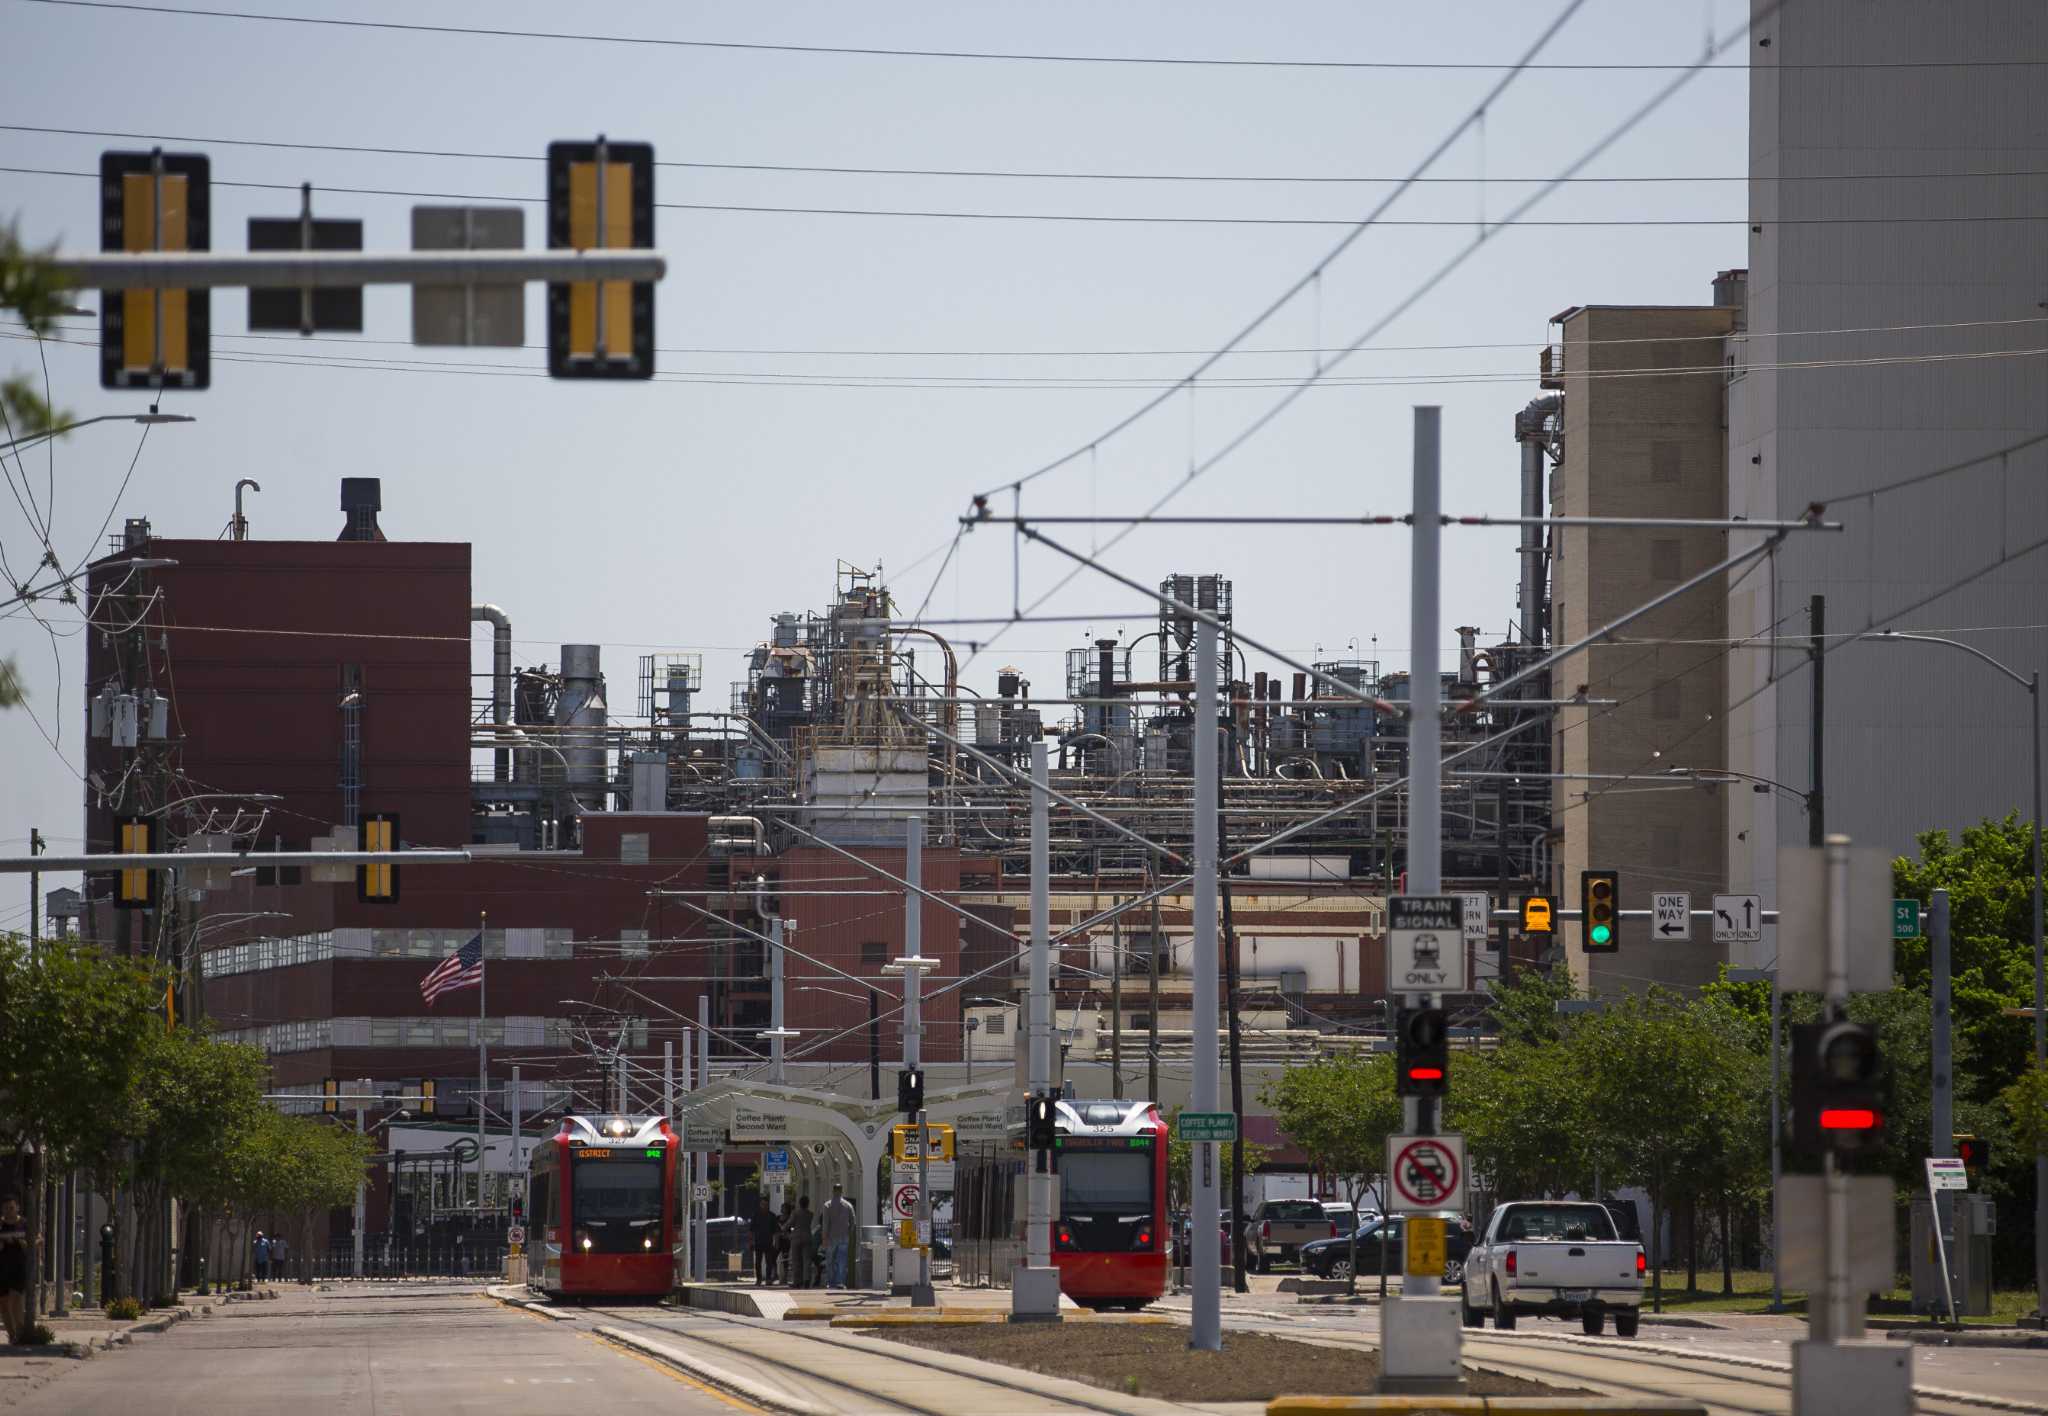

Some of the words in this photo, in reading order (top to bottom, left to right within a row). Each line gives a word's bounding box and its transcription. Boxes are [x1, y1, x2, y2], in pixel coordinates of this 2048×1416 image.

[1401, 900, 1451, 912] TRAIN
[1464, 897, 1480, 906] EFT
[1659, 896, 1684, 907] ONE
[1658, 909, 1684, 920] WAY
[1897, 908, 1910, 919] St
[1395, 916, 1457, 928] SIGNAL
[1716, 930, 1737, 939] ONLY
[1738, 930, 1759, 939] ONLY
[1406, 972, 1448, 984] ONLY
[736, 1113, 761, 1122] Coffee
[957, 1115, 980, 1123] Coffee
[736, 1123, 764, 1131] Second
[766, 1123, 787, 1131] Ward
[1093, 1125, 1114, 1133] 325
